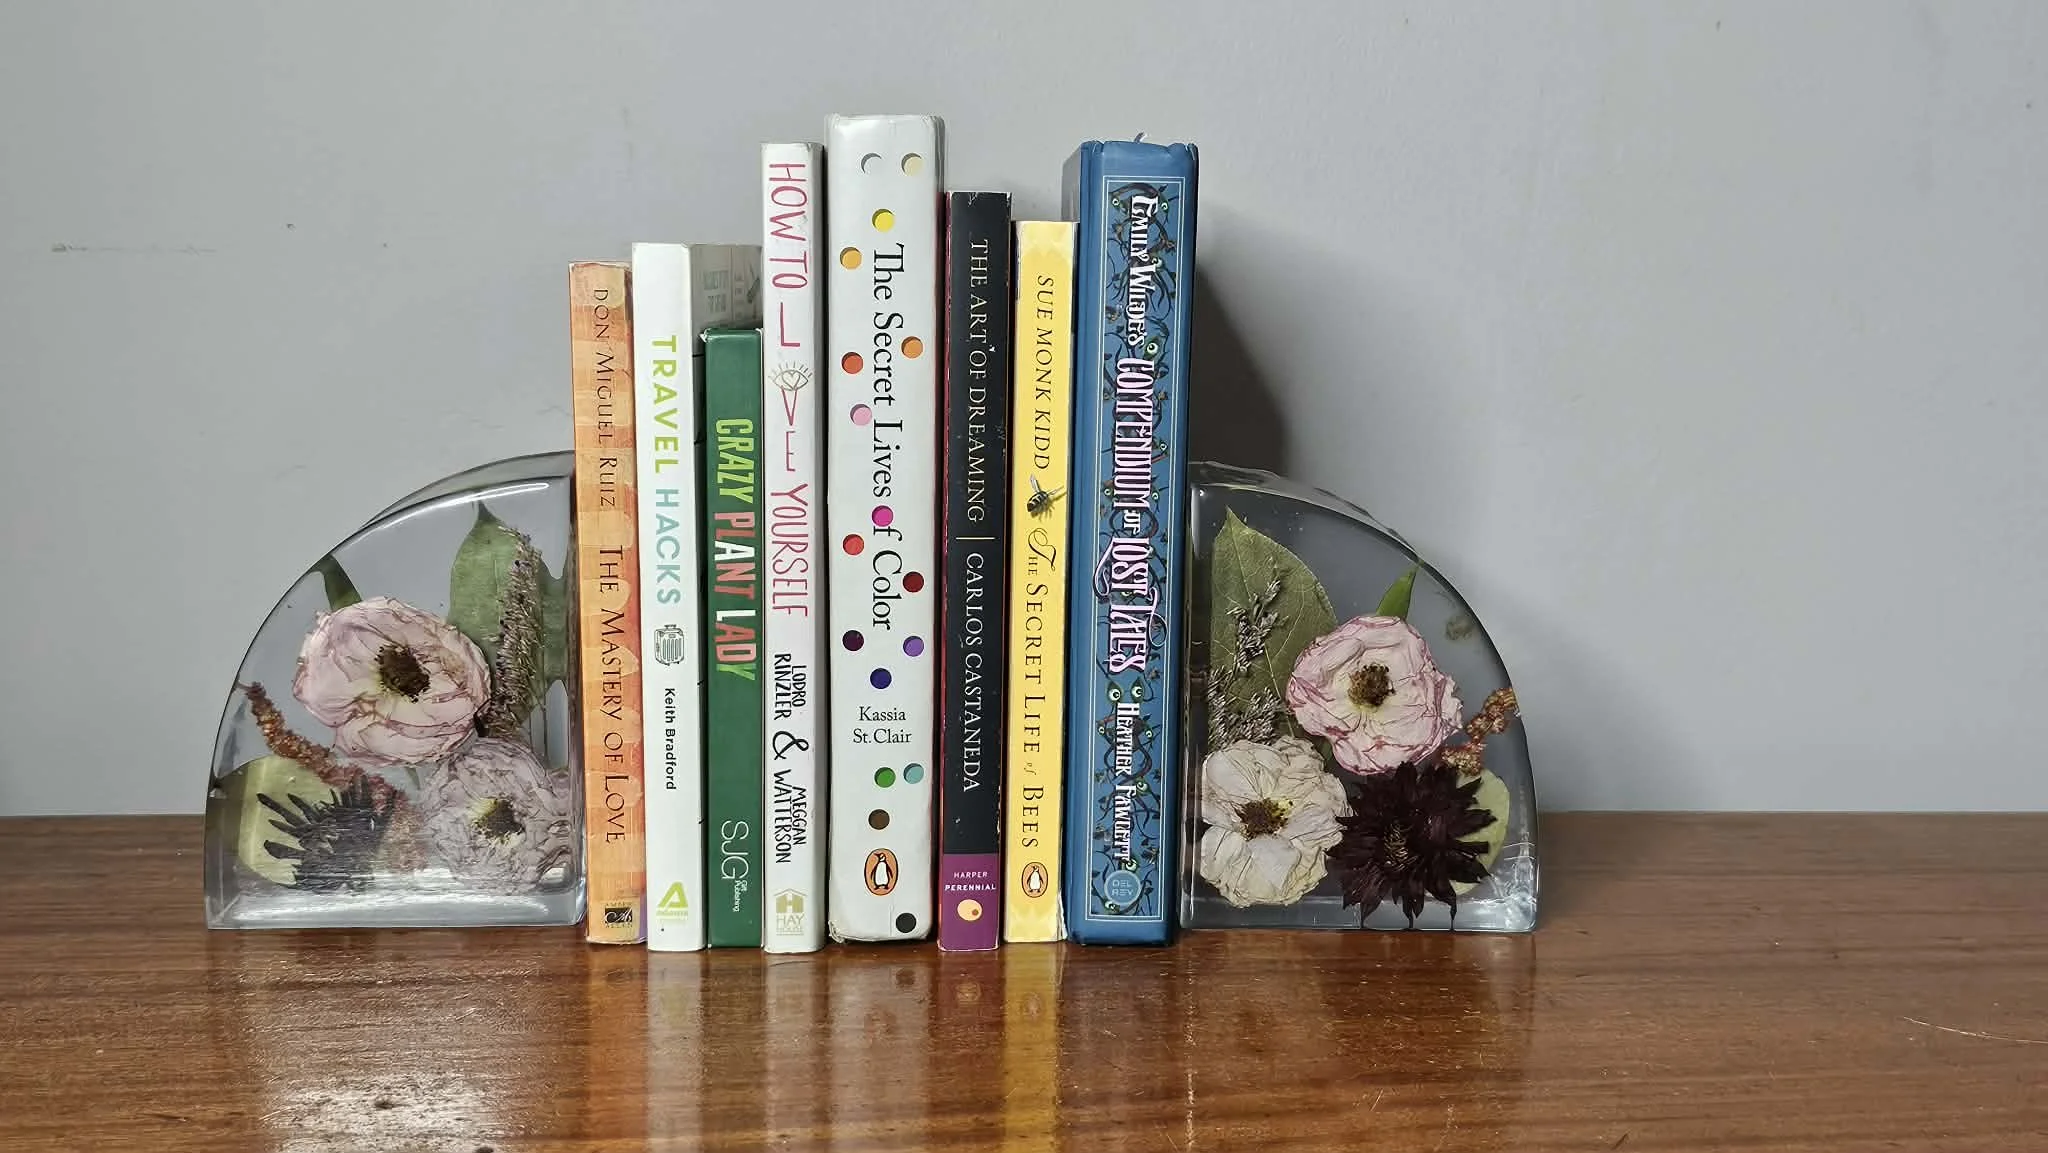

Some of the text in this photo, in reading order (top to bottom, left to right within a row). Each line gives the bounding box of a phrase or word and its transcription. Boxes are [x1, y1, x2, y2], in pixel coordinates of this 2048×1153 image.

[769, 163, 808, 241] HOW
[1130, 195, 1159, 262] EMILY
[769, 251, 808, 289] TO
[873, 243, 905, 300] The
[593, 289, 619, 507] DON MIGUEL RUIZ
[873, 311, 904, 407] Secret
[967, 239, 989, 523] THE ART OF DREAMING
[1033, 275, 1054, 470] SUE MONK KIDD
[652, 335, 680, 605] TRAVEL HACKS
[873, 419, 903, 498] Lives
[714, 418, 757, 681] CRAZY PLANT LADY
[770, 483, 809, 617] YOURSELF
[1093, 356, 1168, 674] COMPENDIUM OF LOST TALES
[872, 550, 903, 631] Color
[963, 552, 984, 793] CARLOS CASTANEDA
[1024, 583, 1049, 686] SECRET
[599, 545, 629, 844] THE MASTERY OF LOVE
[773, 653, 810, 761] RINZLER &
[791, 664, 807, 708] LODRO
[859, 706, 906, 721] Kassia
[1023, 695, 1046, 754] LIFE
[664, 688, 677, 790] Keith Bradford
[853, 728, 912, 744] St. Clair
[1023, 762, 1038, 778] of
[773, 768, 792, 864] WATTERSON
[792, 786, 807, 845] MEGGAN
[1021, 787, 1044, 849] BEES
[1112, 702, 1140, 862] HEATHER FAWCETT
[721, 820, 749, 879] SJG
[1112, 879, 1133, 887] DEL
[776, 914, 805, 926] HAY
[1112, 888, 1134, 897] REY
